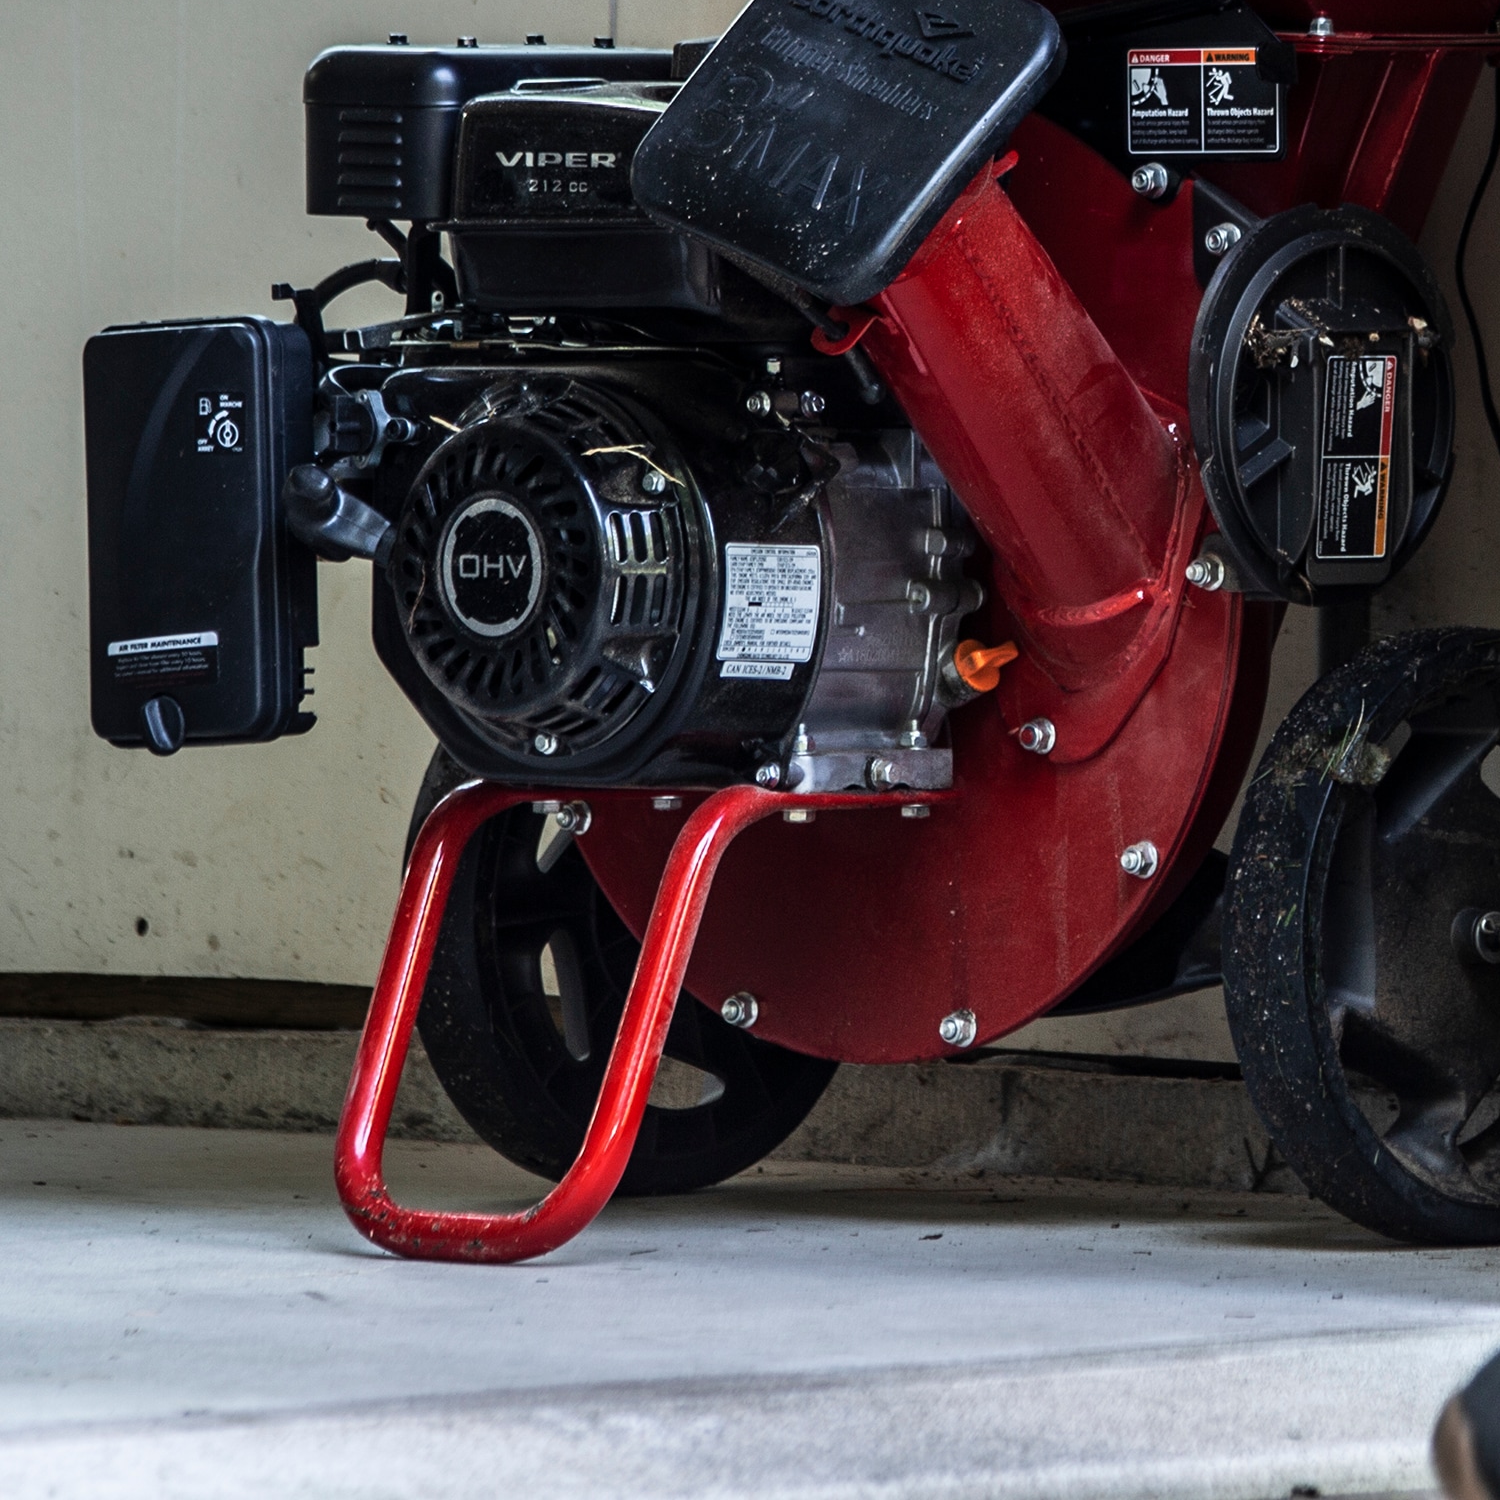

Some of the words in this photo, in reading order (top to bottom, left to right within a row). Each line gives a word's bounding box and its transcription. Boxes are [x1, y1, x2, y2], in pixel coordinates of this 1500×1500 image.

[1140, 54, 1170, 63] DANGER
[1214, 53, 1250, 62] WARNING
[1132, 108, 1167, 119] Amputation
[1167, 108, 1189, 117] Hazard
[1206, 107, 1230, 116] Thrown
[1230, 107, 1252, 119] Objects
[1252, 107, 1274, 116] Hazard
[496, 151, 617, 168] VIPER
[732, 122, 890, 230] MAX
[529, 180, 562, 192] 212
[1349, 361, 1357, 408] Amputation
[1384, 372, 1393, 412] DANGER
[1377, 473, 1386, 520] WARNING
[459, 554, 527, 579] OHV
[119, 644, 128, 652] AIR
[130, 642, 148, 651] FILTER
[150, 637, 202, 649] MAINTENANCE
[726, 664, 741, 674] CAN
